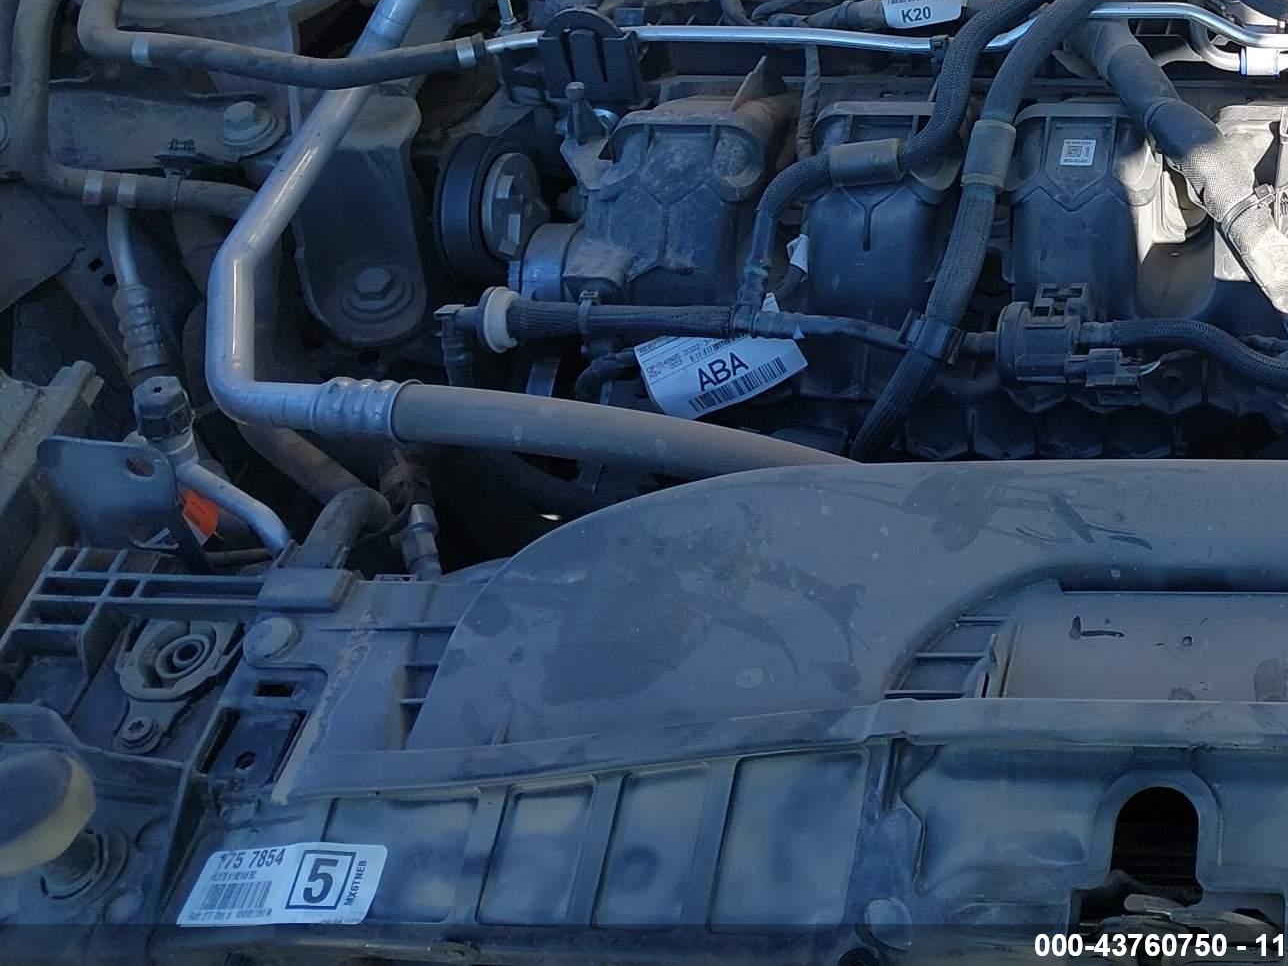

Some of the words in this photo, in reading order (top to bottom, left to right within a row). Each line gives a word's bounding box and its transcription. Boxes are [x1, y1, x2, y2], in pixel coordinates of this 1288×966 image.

[901, 5, 932, 24] K20
[697, 352, 750, 392] ABA
[248, 848, 286, 868] 7854
[302, 858, 338, 904] 5
